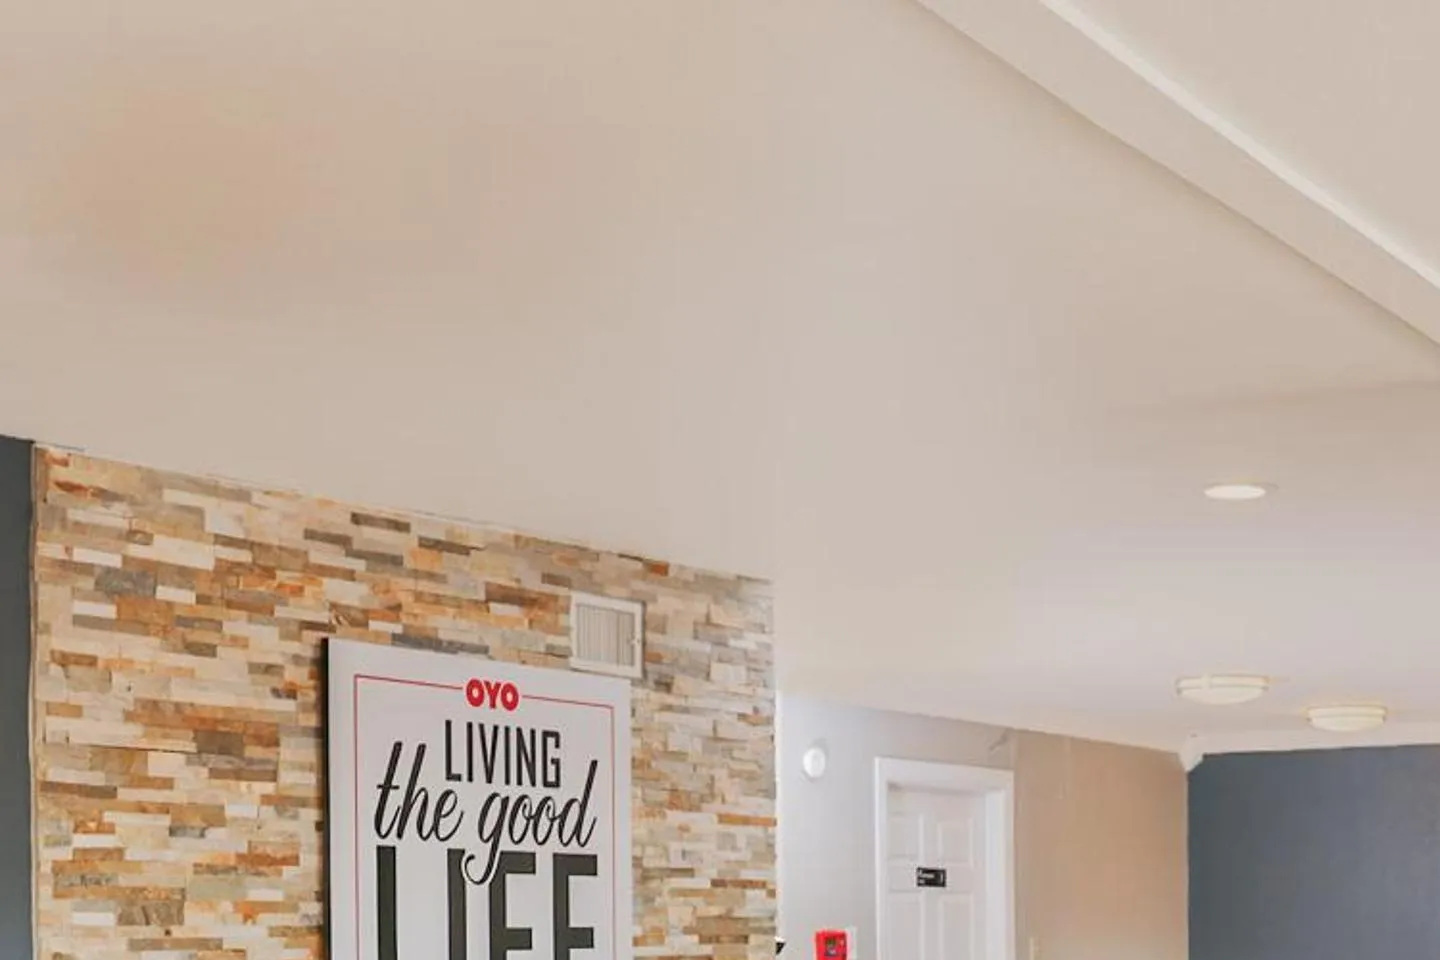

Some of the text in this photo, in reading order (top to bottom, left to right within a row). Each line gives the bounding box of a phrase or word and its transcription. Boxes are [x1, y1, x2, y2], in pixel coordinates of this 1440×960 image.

[466, 678, 519, 711] OYO
[445, 719, 561, 788] LIVING
[374, 741, 599, 885] the good
